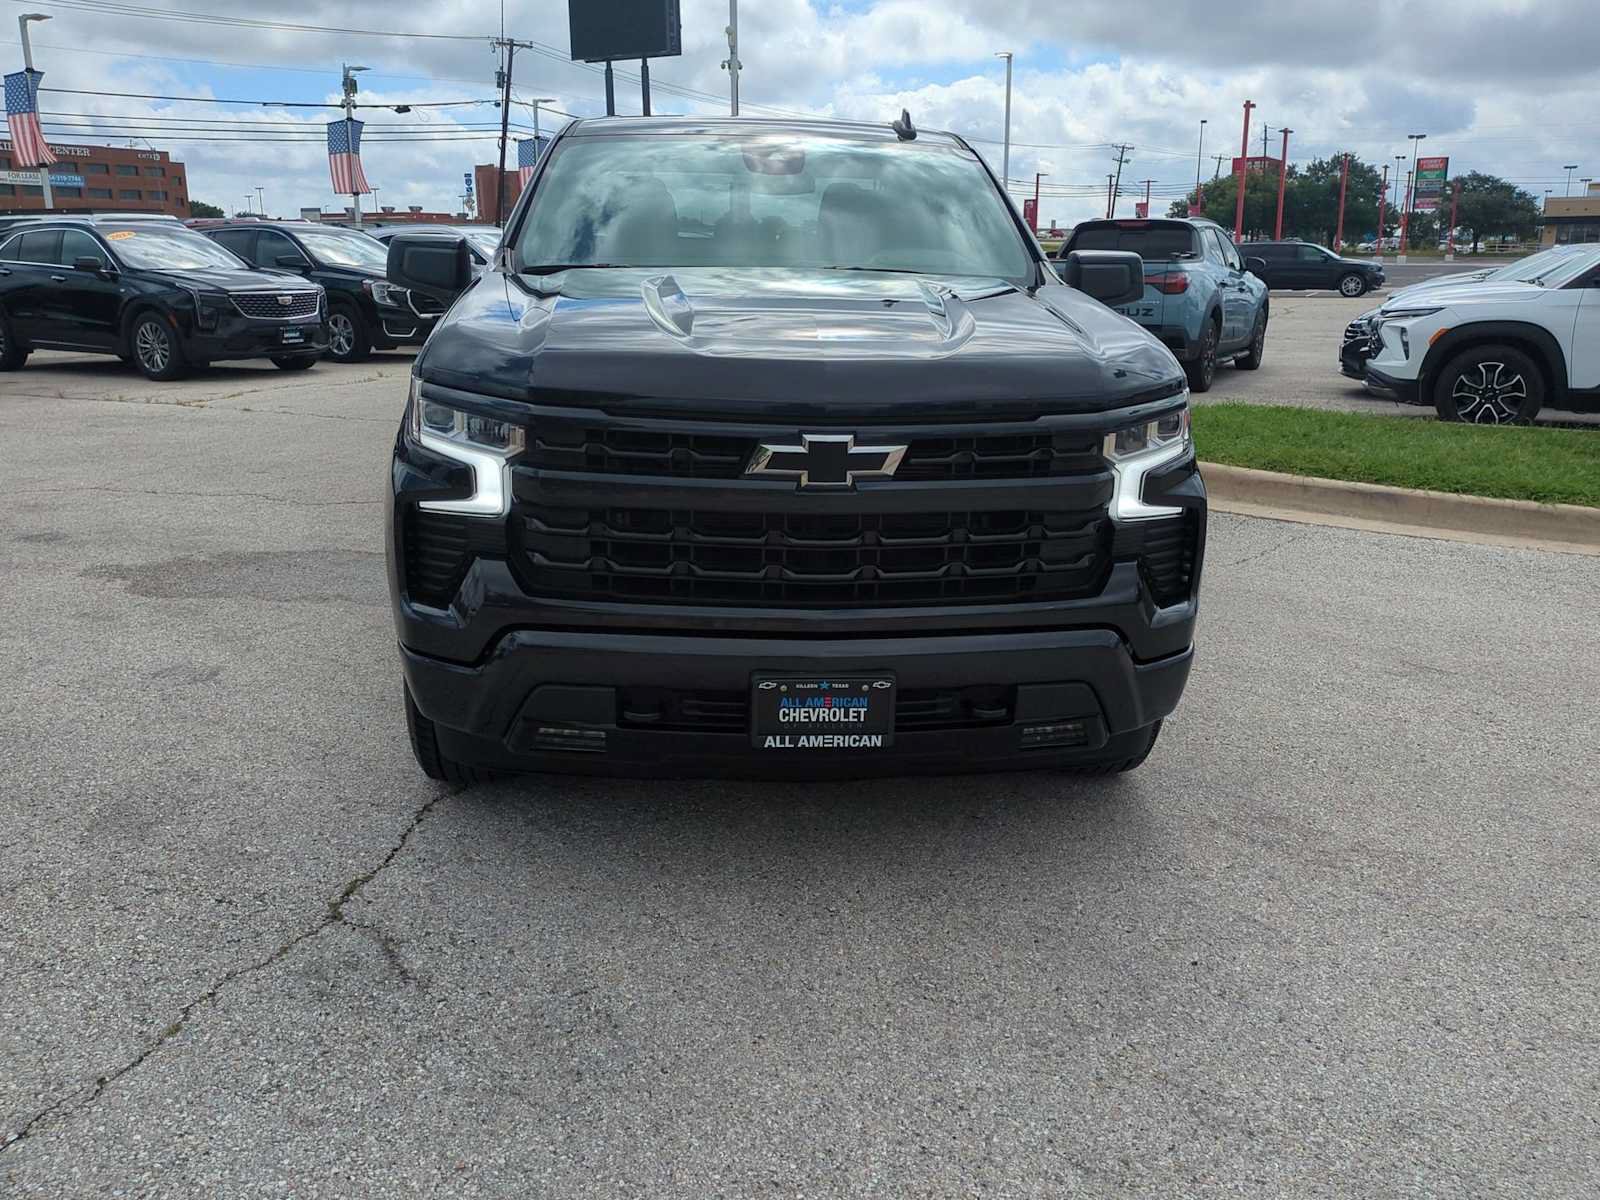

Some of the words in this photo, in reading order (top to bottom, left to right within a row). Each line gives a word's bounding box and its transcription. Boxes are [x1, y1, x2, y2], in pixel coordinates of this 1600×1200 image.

[49, 145, 91, 157] CENTER
[1113, 307, 1153, 317] RUZ
[780, 697, 802, 708] ALL
[805, 697, 868, 708] AMERICAN
[779, 708, 868, 722] CHEVROLET
[764, 735, 795, 748] ALL
[797, 735, 882, 748] AMERICAN
